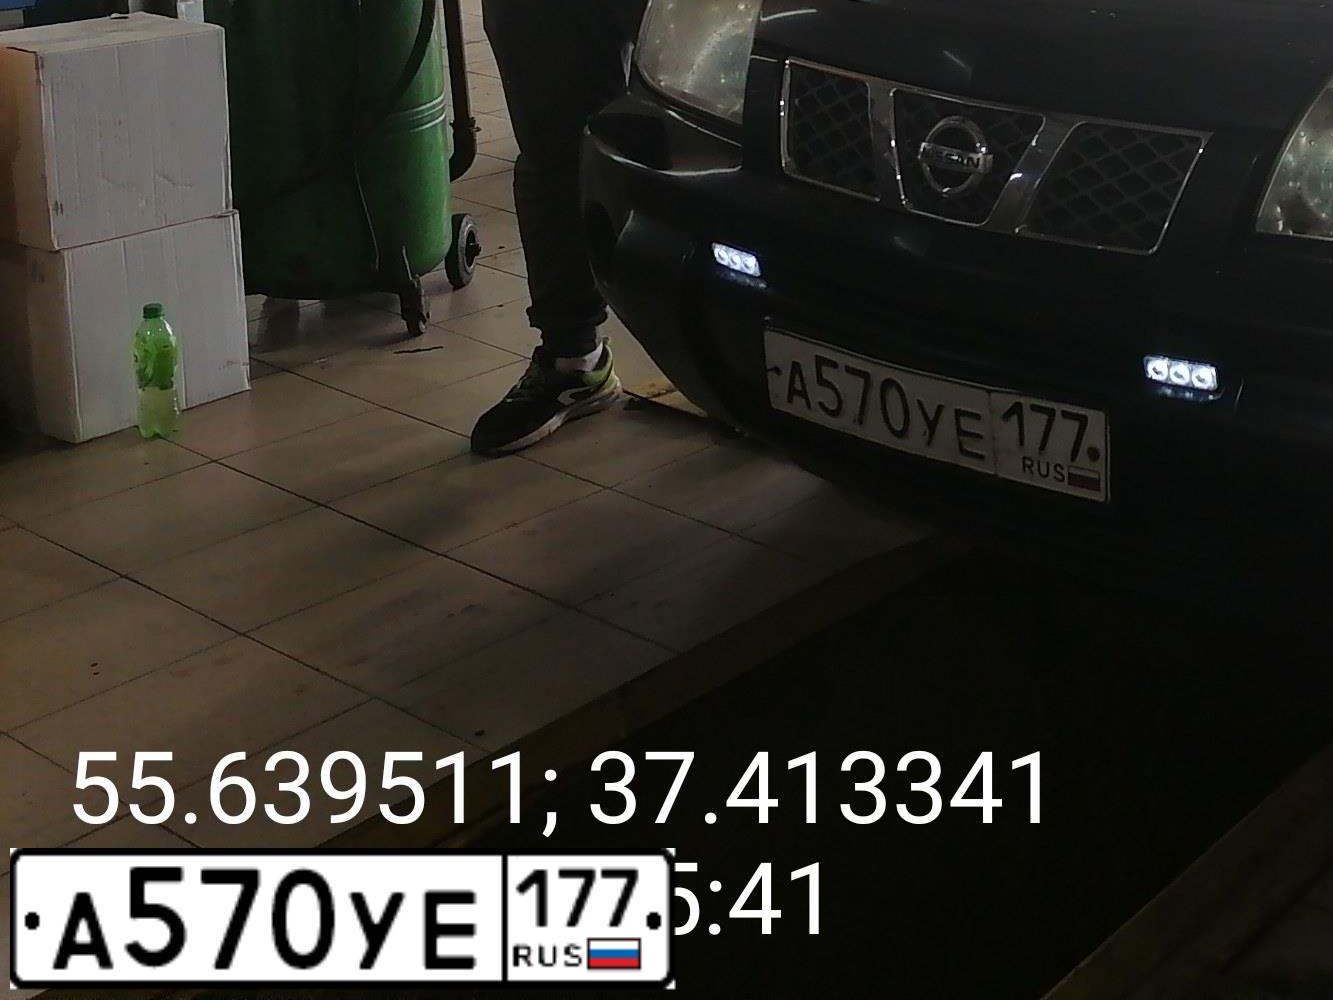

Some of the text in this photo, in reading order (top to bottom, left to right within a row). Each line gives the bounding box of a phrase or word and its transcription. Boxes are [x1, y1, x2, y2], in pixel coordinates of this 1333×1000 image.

[787, 354, 1089, 463] А570УЕ 177
[1022, 455, 1065, 483] RUS
